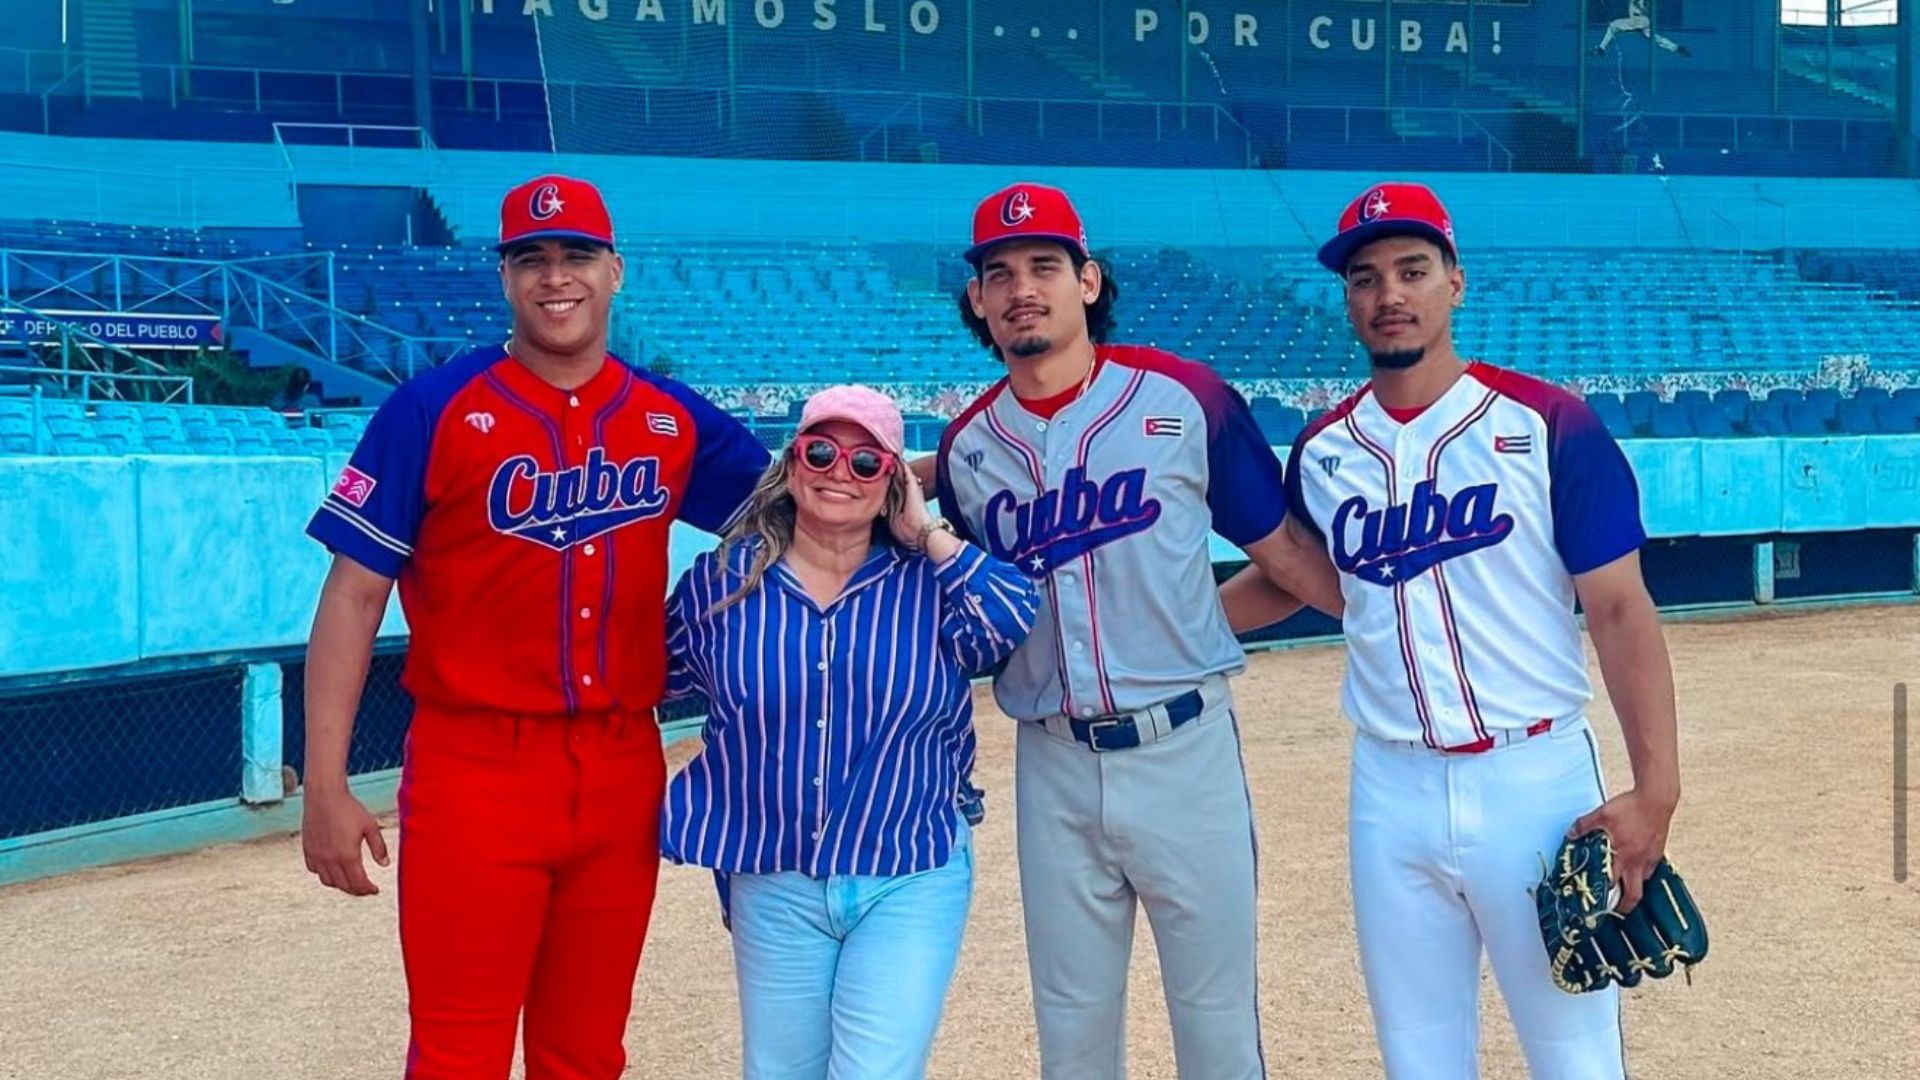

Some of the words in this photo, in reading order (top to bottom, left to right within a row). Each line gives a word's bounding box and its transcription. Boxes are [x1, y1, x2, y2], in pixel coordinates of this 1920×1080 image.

[1135, 9, 1259, 46] POR
[1309, 17, 1501, 54] CUBA!
[106, 323, 135, 338] DEL
[138, 324, 197, 339] PUEBLO
[487, 446, 669, 533] Cuba
[985, 466, 1161, 562] Cuba
[1332, 478, 1514, 573] Cuba
